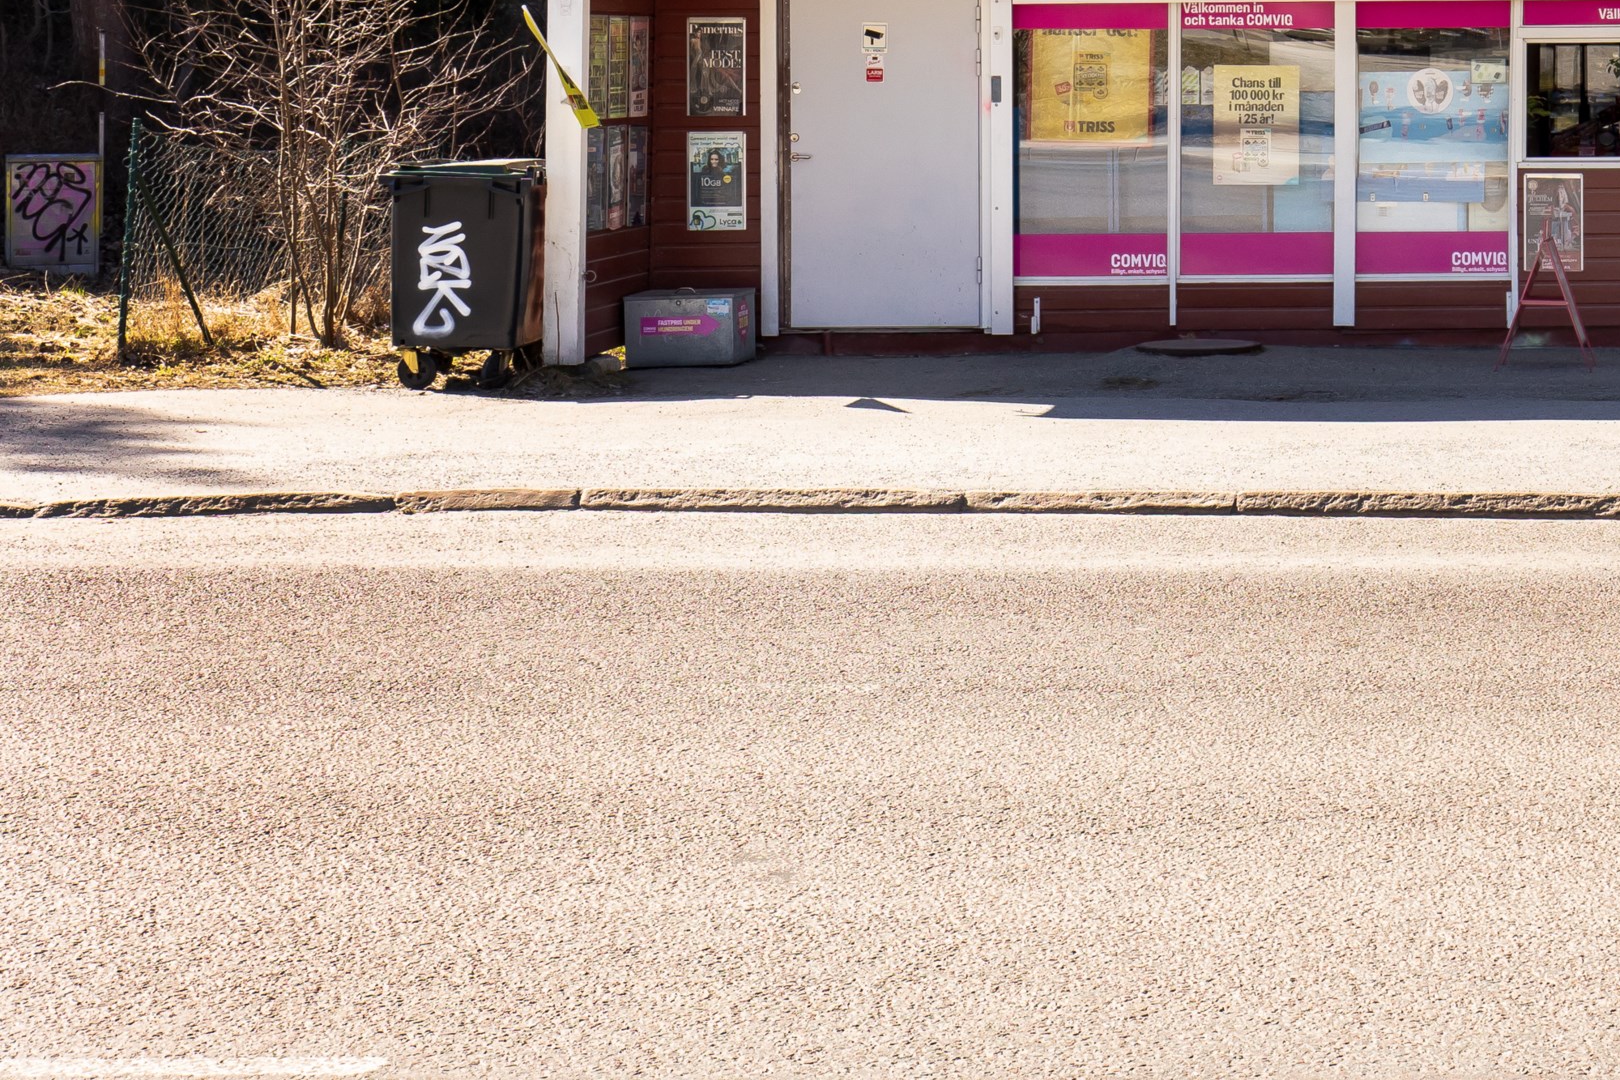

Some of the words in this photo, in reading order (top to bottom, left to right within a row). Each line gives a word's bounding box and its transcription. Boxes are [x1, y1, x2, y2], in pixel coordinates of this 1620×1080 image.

[1182, 2, 1250, 14] Välkommen
[1253, 2, 1264, 13] in
[1184, 14, 1206, 25] och
[1208, 15, 1244, 25] tanka
[1246, 14, 1293, 26] COMVIQ
[1232, 77, 1265, 88] Chans
[1269, 77, 1281, 88] till
[1229, 90, 1248, 100] 100
[1250, 90, 1270, 100] 000
[1273, 90, 1284, 100] kr
[1229, 101, 1232, 111] i
[1234, 101, 1284, 111] månaden
[1239, 114, 1242, 124] i
[1244, 114, 1257, 124] 25
[1260, 113, 1274, 124] år!
[1078, 121, 1115, 132] TRISS
[1111, 254, 1167, 268] COMVIQ
[1452, 252, 1507, 266] COMVIQ
